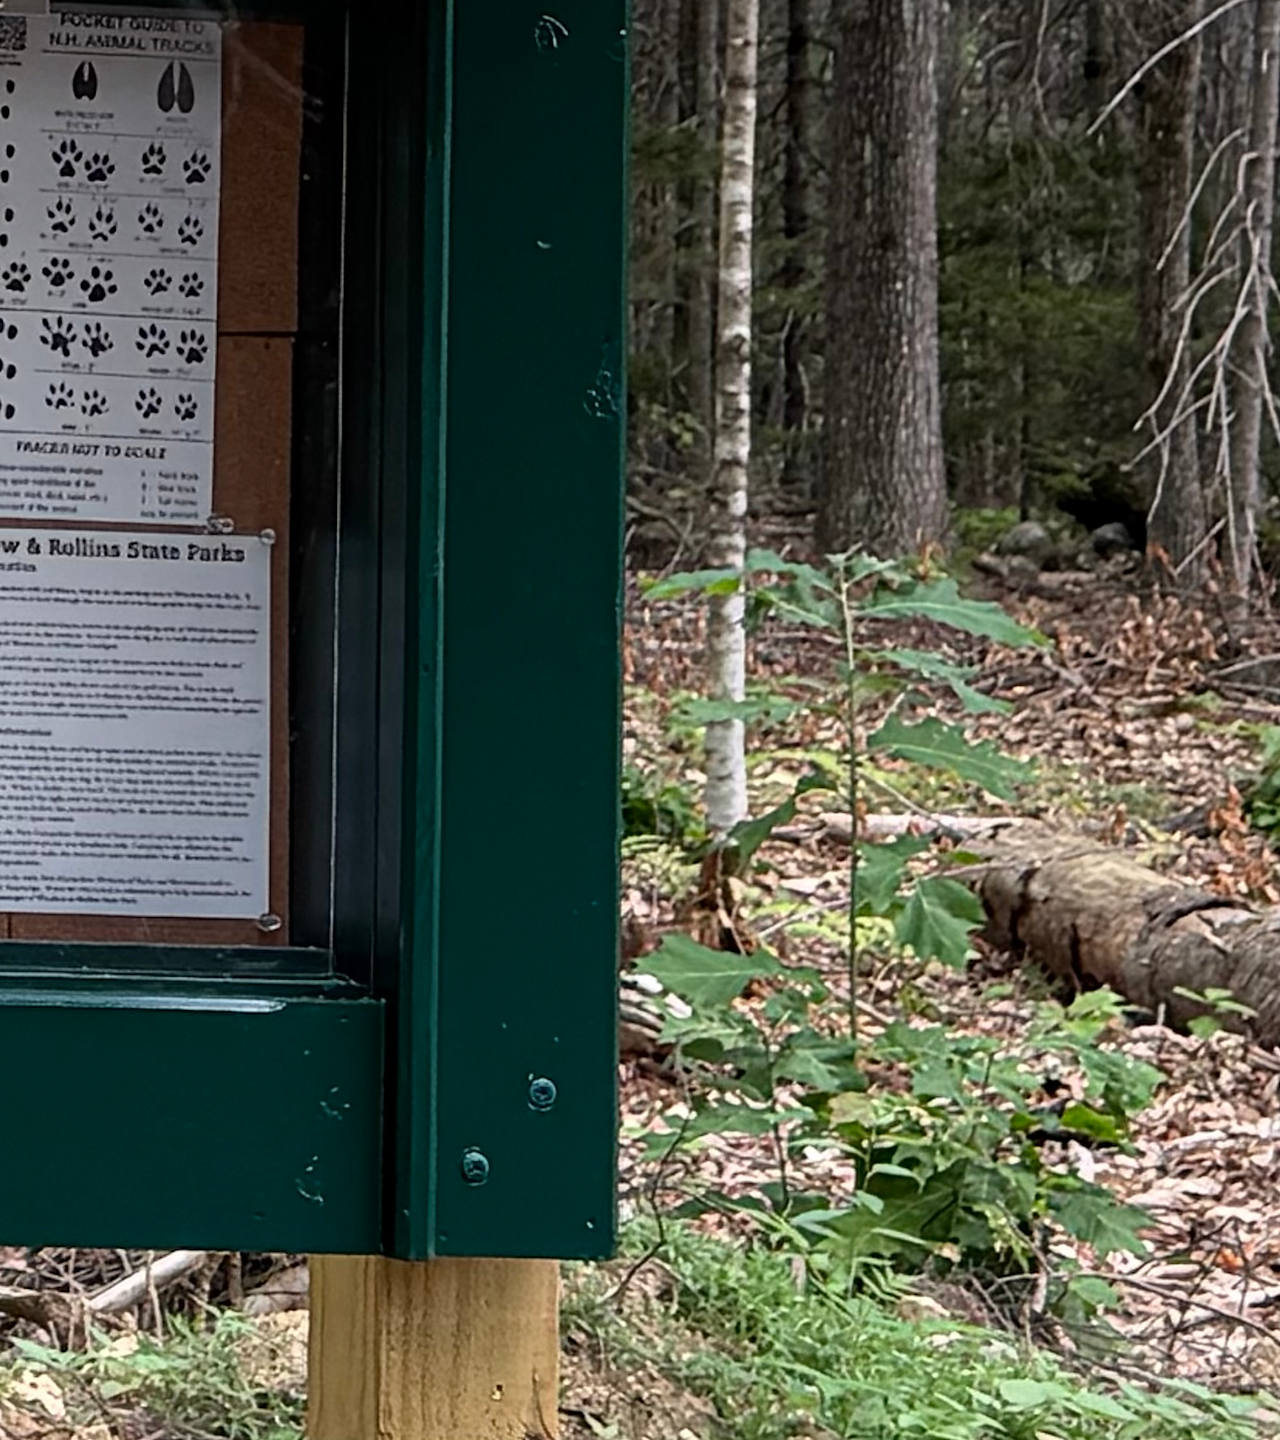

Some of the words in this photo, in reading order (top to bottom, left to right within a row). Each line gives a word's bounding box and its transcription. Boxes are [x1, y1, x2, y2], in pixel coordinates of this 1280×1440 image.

[27, 538, 42, 556] &
[49, 538, 121, 559] Rollins
[127, 542, 182, 561] State
[188, 544, 246, 563] Parks
